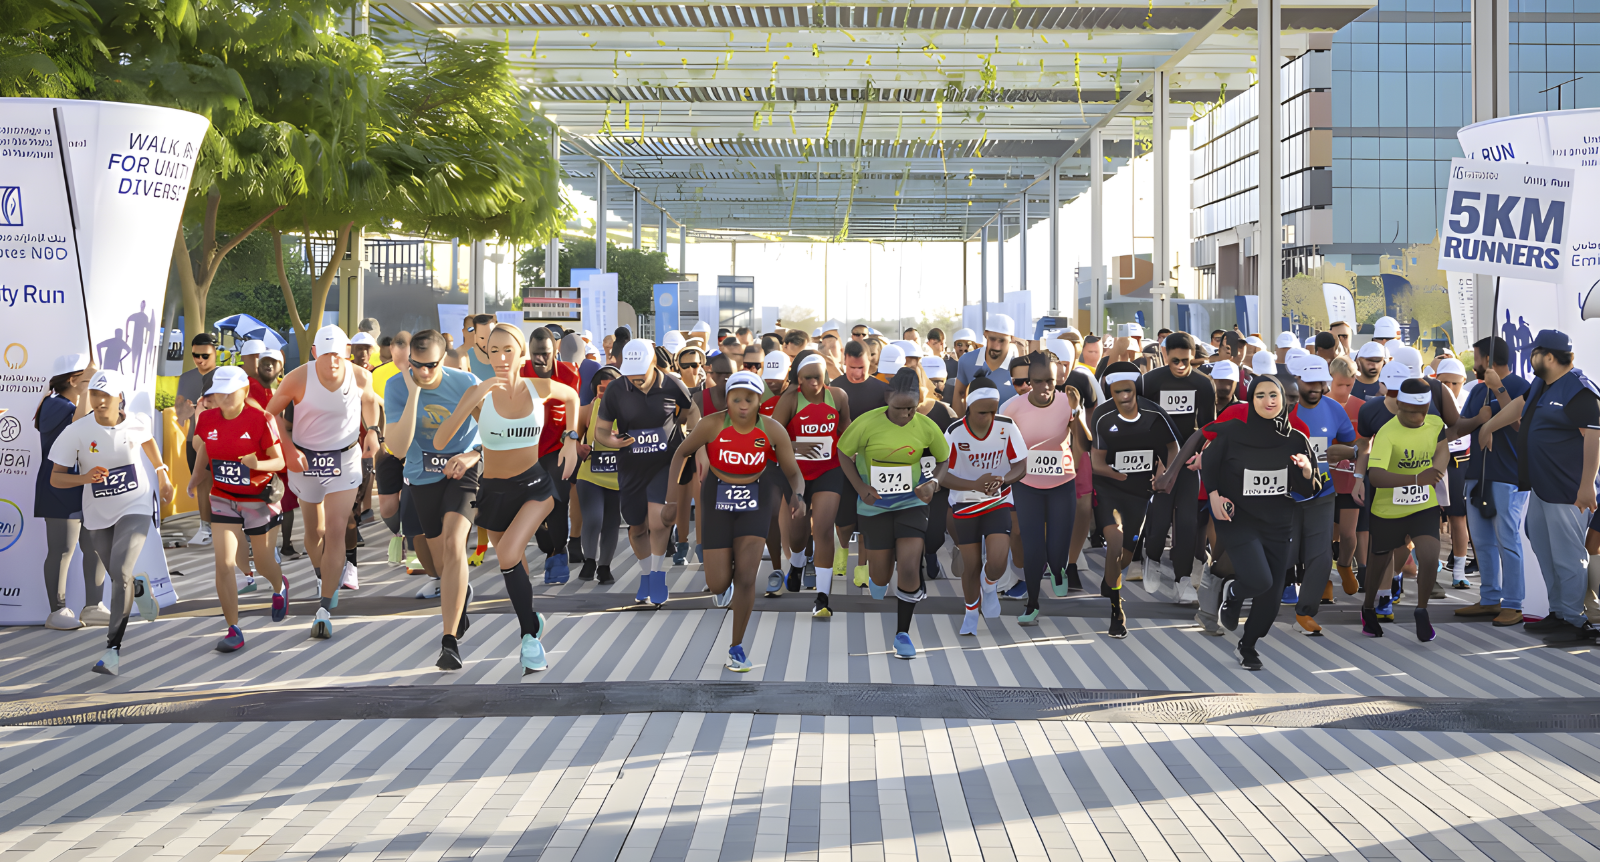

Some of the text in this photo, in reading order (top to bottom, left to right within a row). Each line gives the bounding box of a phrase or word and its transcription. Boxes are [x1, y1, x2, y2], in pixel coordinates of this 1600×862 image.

[1481, 142, 1516, 162] RUN
[107, 153, 151, 174] FOR
[1448, 190, 1566, 245] 5KM
[1443, 236, 1560, 270] RUNNERS
[23, 284, 65, 304] Run
[311, 456, 335, 467] 102
[430, 456, 449, 467] 00
[718, 448, 765, 466] KENYA
[102, 471, 127, 486] 127
[217, 465, 241, 477] 121
[878, 472, 902, 483] 371
[724, 489, 752, 500] 122
